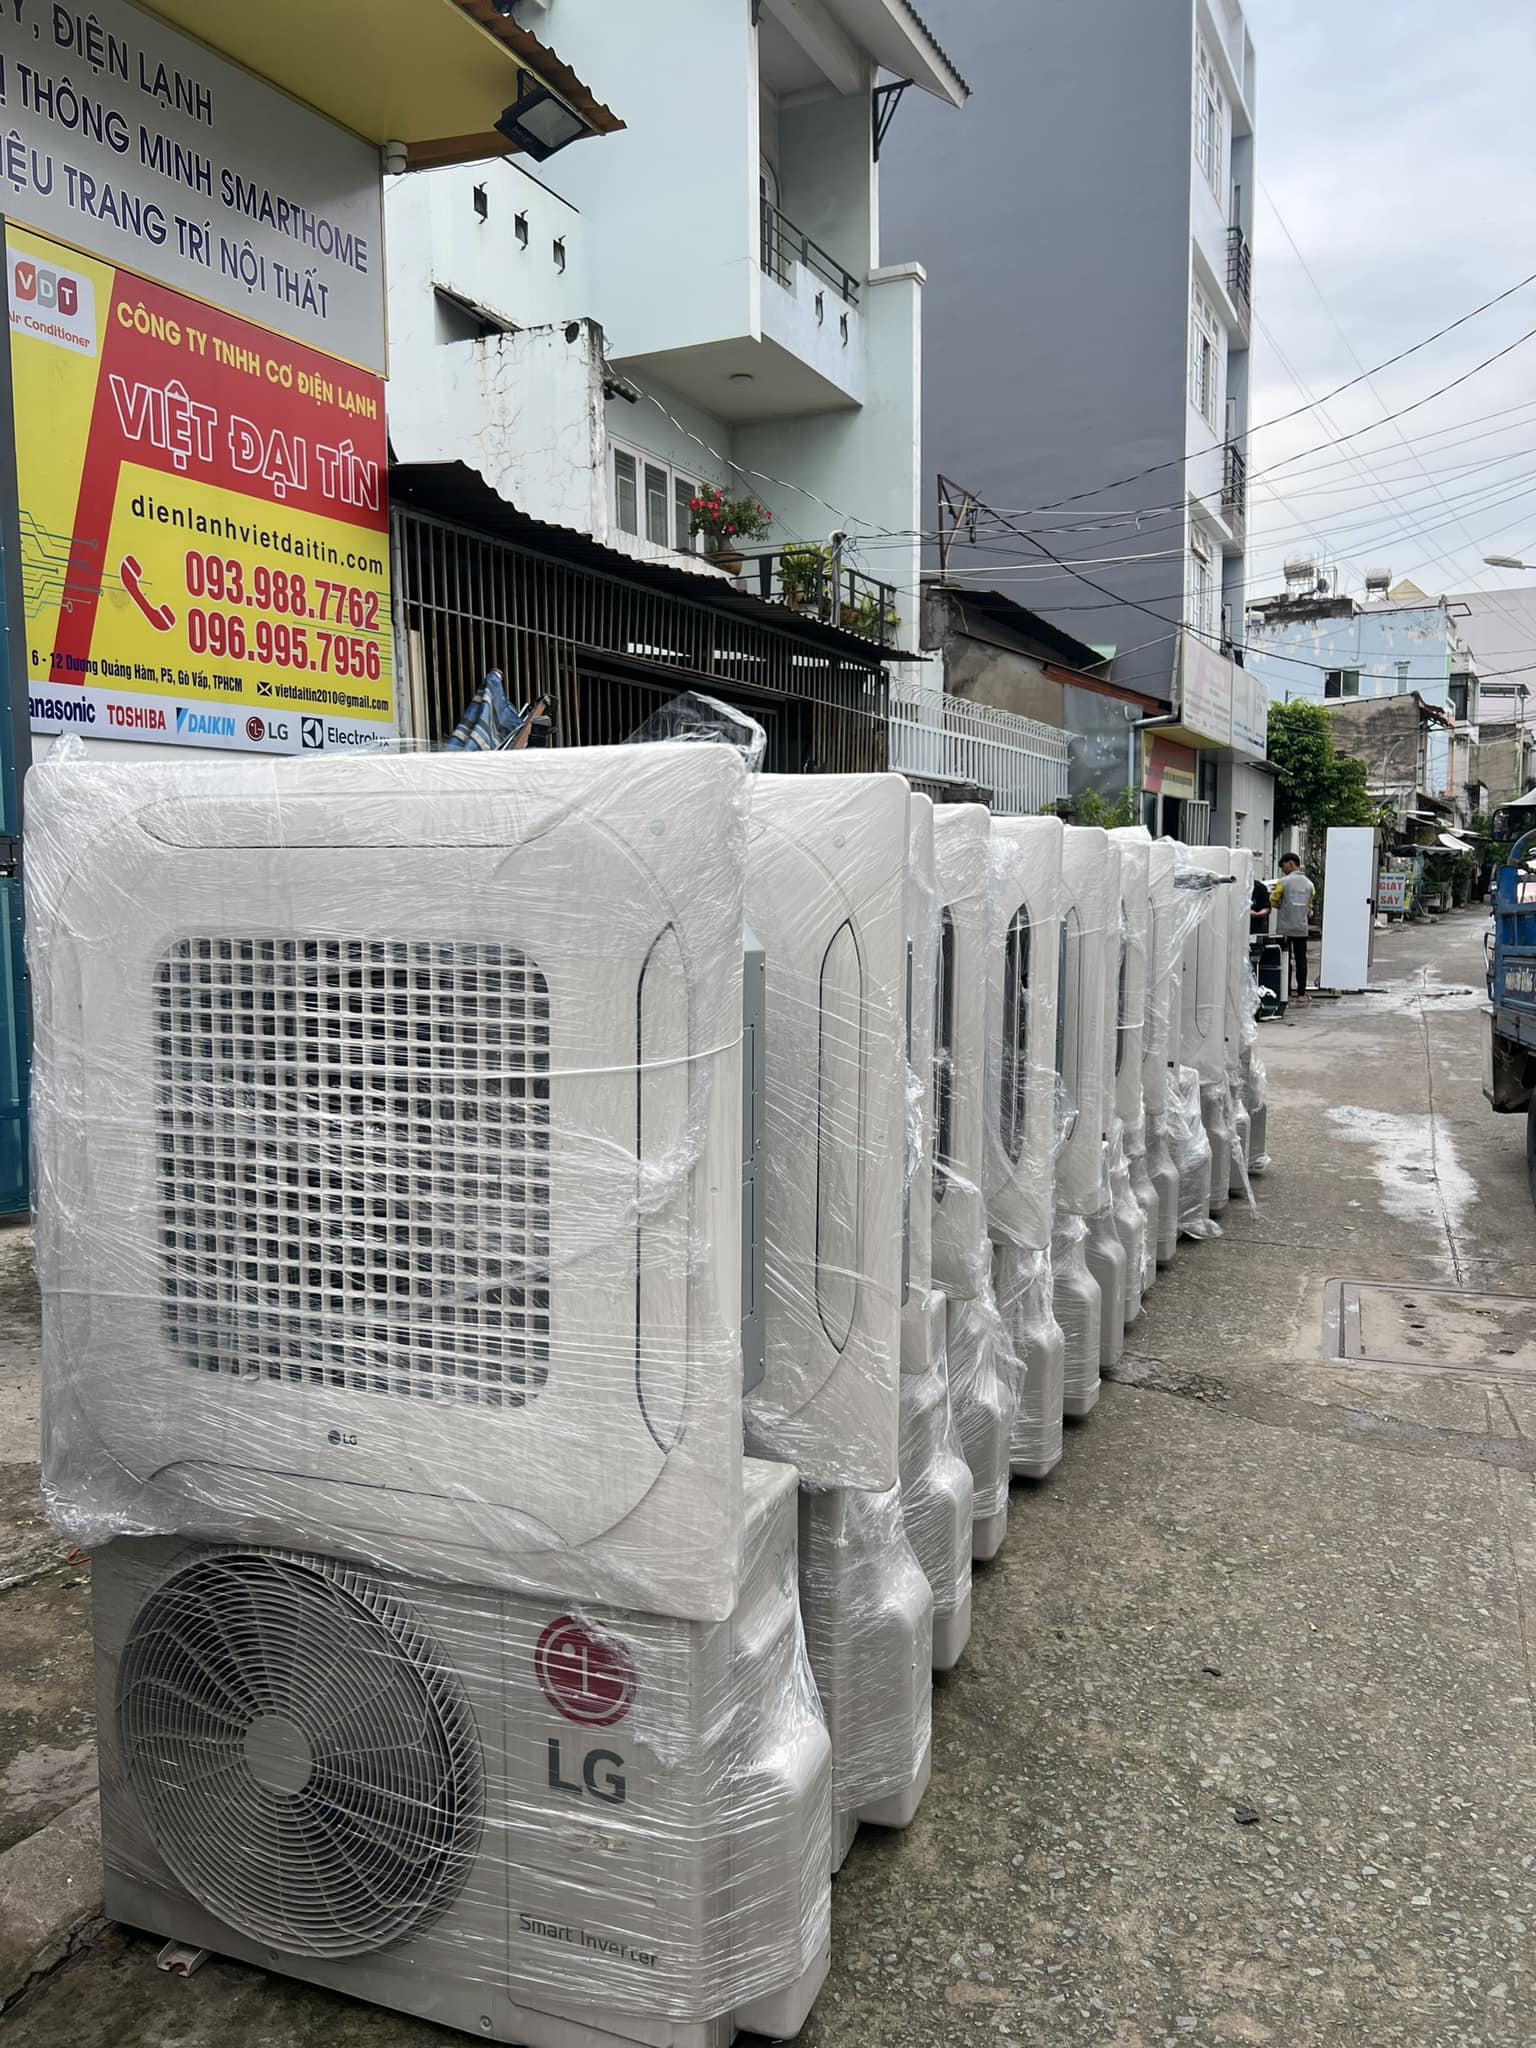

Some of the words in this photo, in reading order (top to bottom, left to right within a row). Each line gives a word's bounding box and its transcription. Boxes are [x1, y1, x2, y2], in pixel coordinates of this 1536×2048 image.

[53, 3, 128, 81] ĐIỆN
[139, 50, 213, 125] LẠNH
[17, 63, 130, 153] THÔNG
[139, 125, 212, 197] MINH
[221, 168, 368, 274] SMARTHOME
[63, 164, 167, 245] TRANG
[174, 216, 211, 267] TRÍ
[220, 238, 266, 293] NỘI
[273, 261, 329, 319] THẤT
[17, 267, 75, 308] VDT
[24, 315, 91, 349] Conditioner
[117, 302, 182, 346] CÔNG
[186, 327, 208, 356] TY
[212, 336, 261, 377] TNHH
[265, 360, 293, 389] CƠ
[297, 371, 333, 406] ĐIỆN
[338, 386, 377, 420] LẠNH
[108, 373, 218, 470] VIỆT
[228, 414, 308, 499] ĐẠI
[316, 438, 380, 511] TÍN
[131, 495, 384, 576] dienlanhvietdaitin.com
[185, 550, 380, 632] 093.988.7762
[50, 652, 63, 669] 12
[101, 658, 132, 680] Quảng
[161, 667, 176, 685] P5,
[178, 670, 190, 687] Gò
[213, 675, 243, 693] TPHCM
[187, 607, 381, 682] 096.995.7956
[107, 704, 167, 730] TOSHIBA
[188, 713, 236, 737] DAIKIN
[268, 721, 289, 740] LG
[275, 684, 389, 712] vietdaitin2010@gmail.com
[342, 1433, 358, 1446] LG
[548, 1737, 626, 1804] LG
[519, 1911, 574, 1943] Smart
[580, 1929, 659, 1967] Inverter
